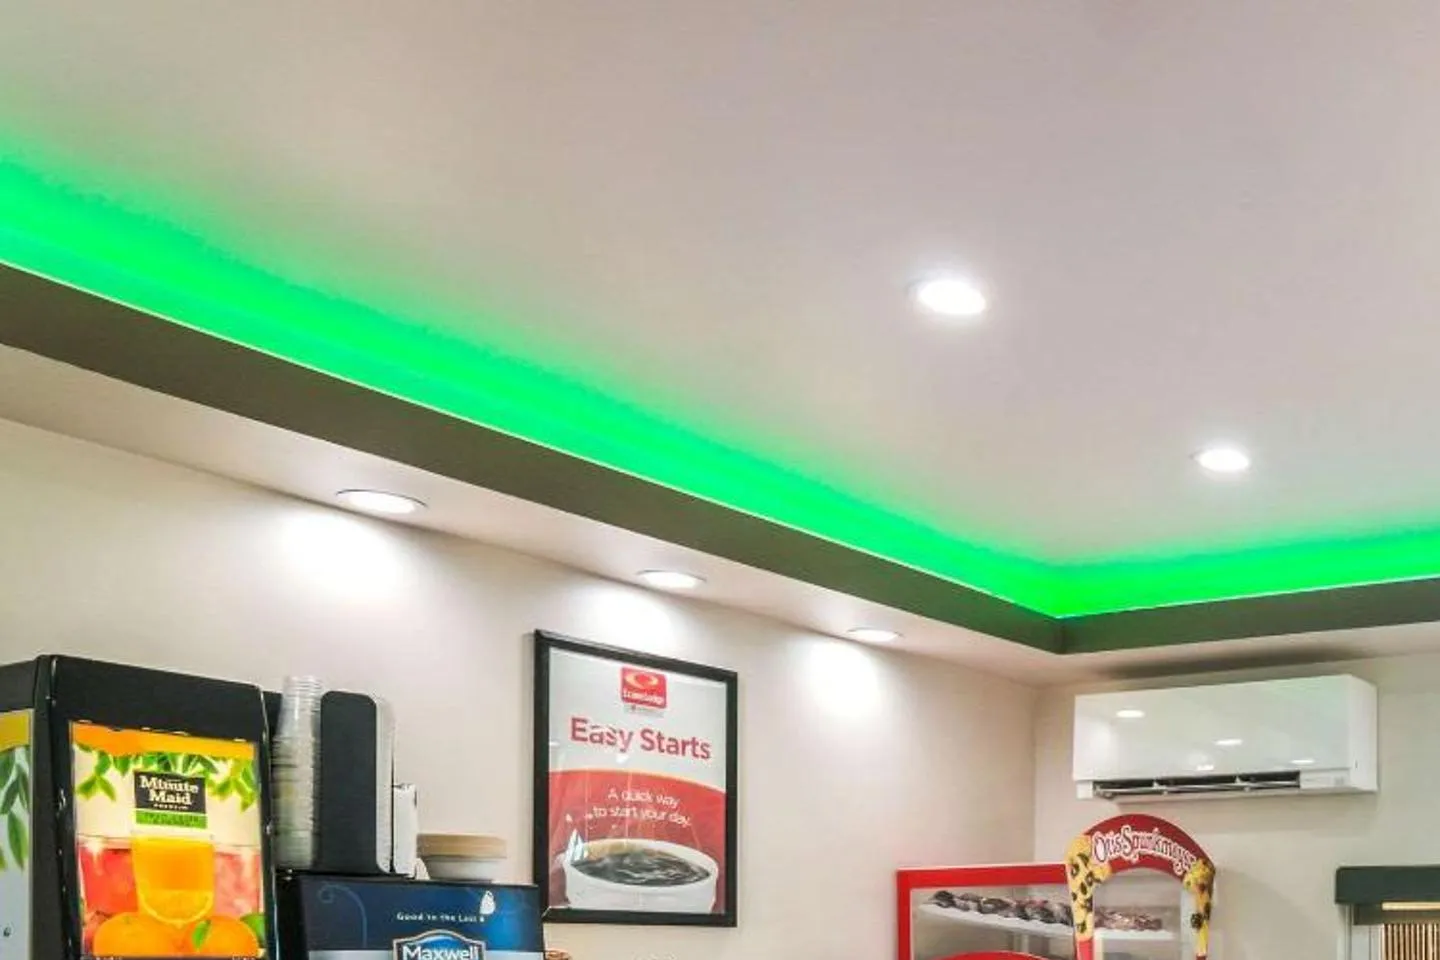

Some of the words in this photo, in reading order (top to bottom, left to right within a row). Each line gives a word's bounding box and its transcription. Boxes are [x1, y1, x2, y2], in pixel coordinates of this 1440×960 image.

[570, 717, 634, 753] Easy
[640, 727, 711, 760] Starts
[139, 775, 199, 794] Minute
[150, 790, 192, 805] Maid
[607, 789, 618, 799] A
[656, 794, 680, 808] way
[593, 806, 606, 816] to
[610, 807, 638, 818] start
[397, 911, 423, 921] Good
